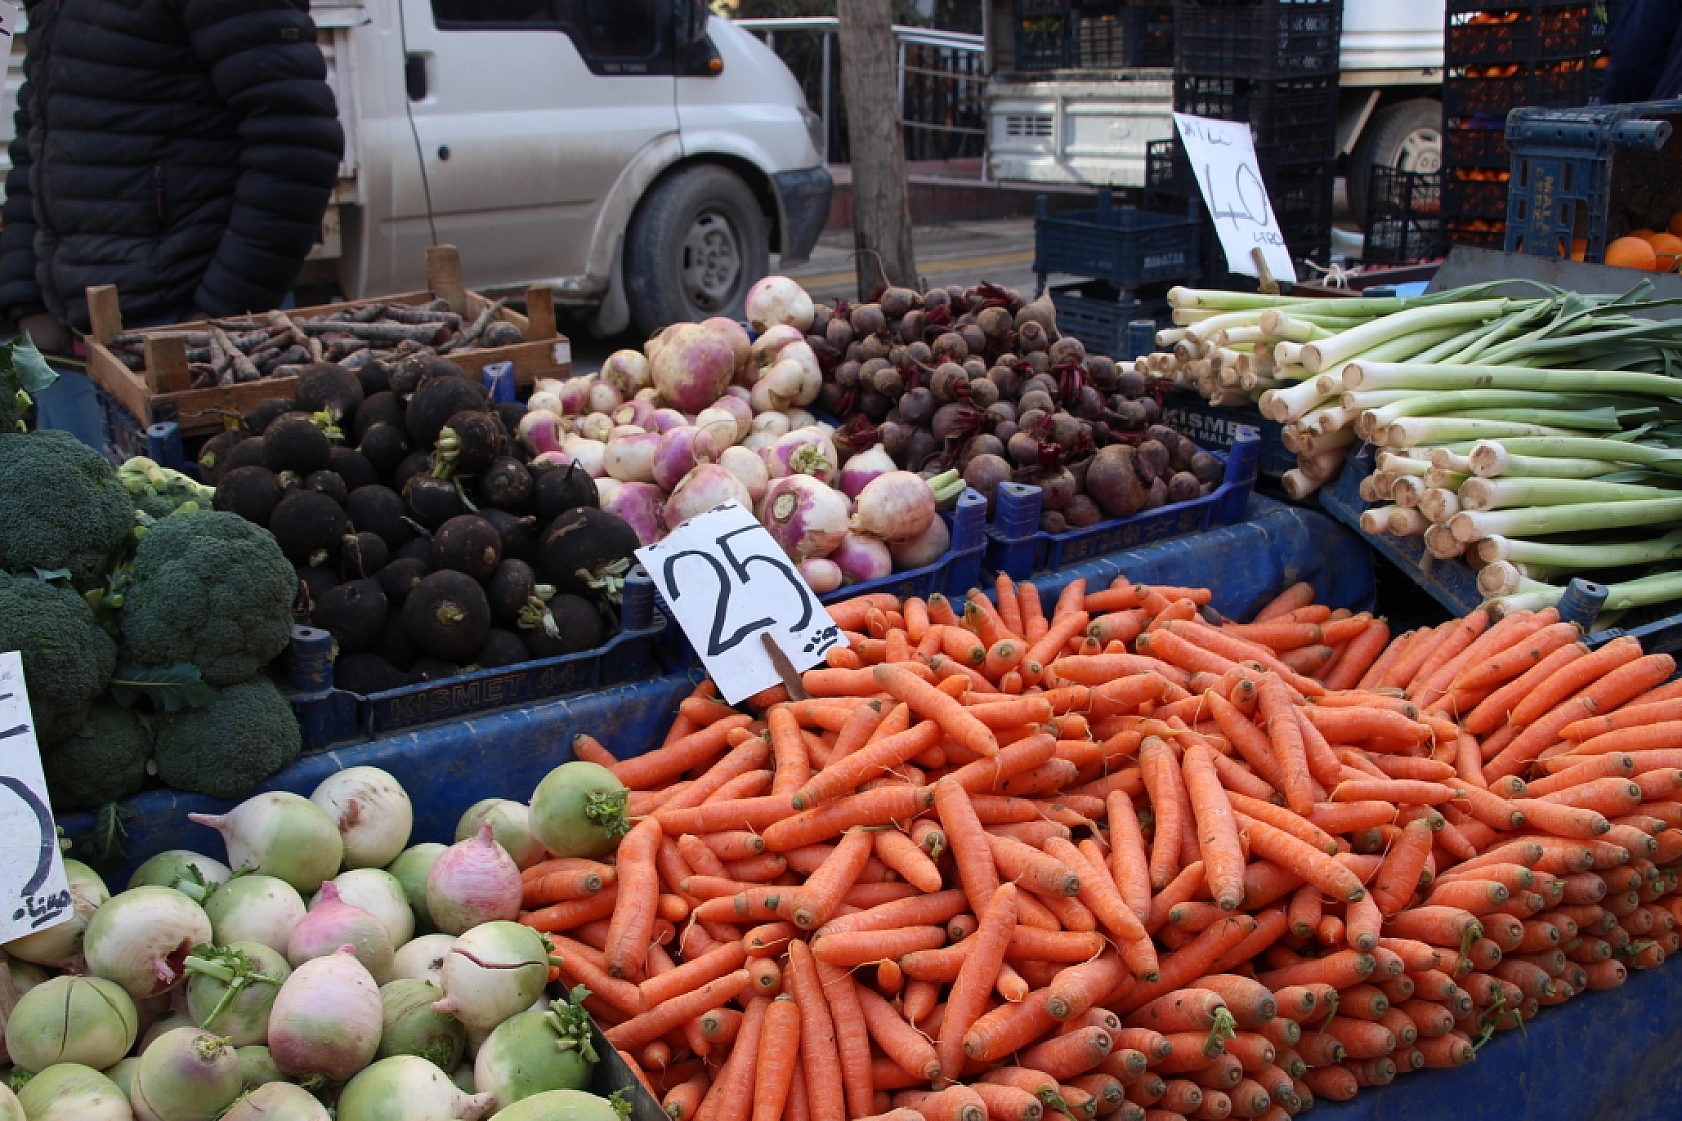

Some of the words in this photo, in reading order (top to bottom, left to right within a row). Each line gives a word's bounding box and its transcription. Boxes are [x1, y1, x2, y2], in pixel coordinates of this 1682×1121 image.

[1204, 161, 1268, 232] 40
[663, 523, 813, 657] 25
[390, 672, 527, 723] KISMET
[537, 663, 576, 694] 44
